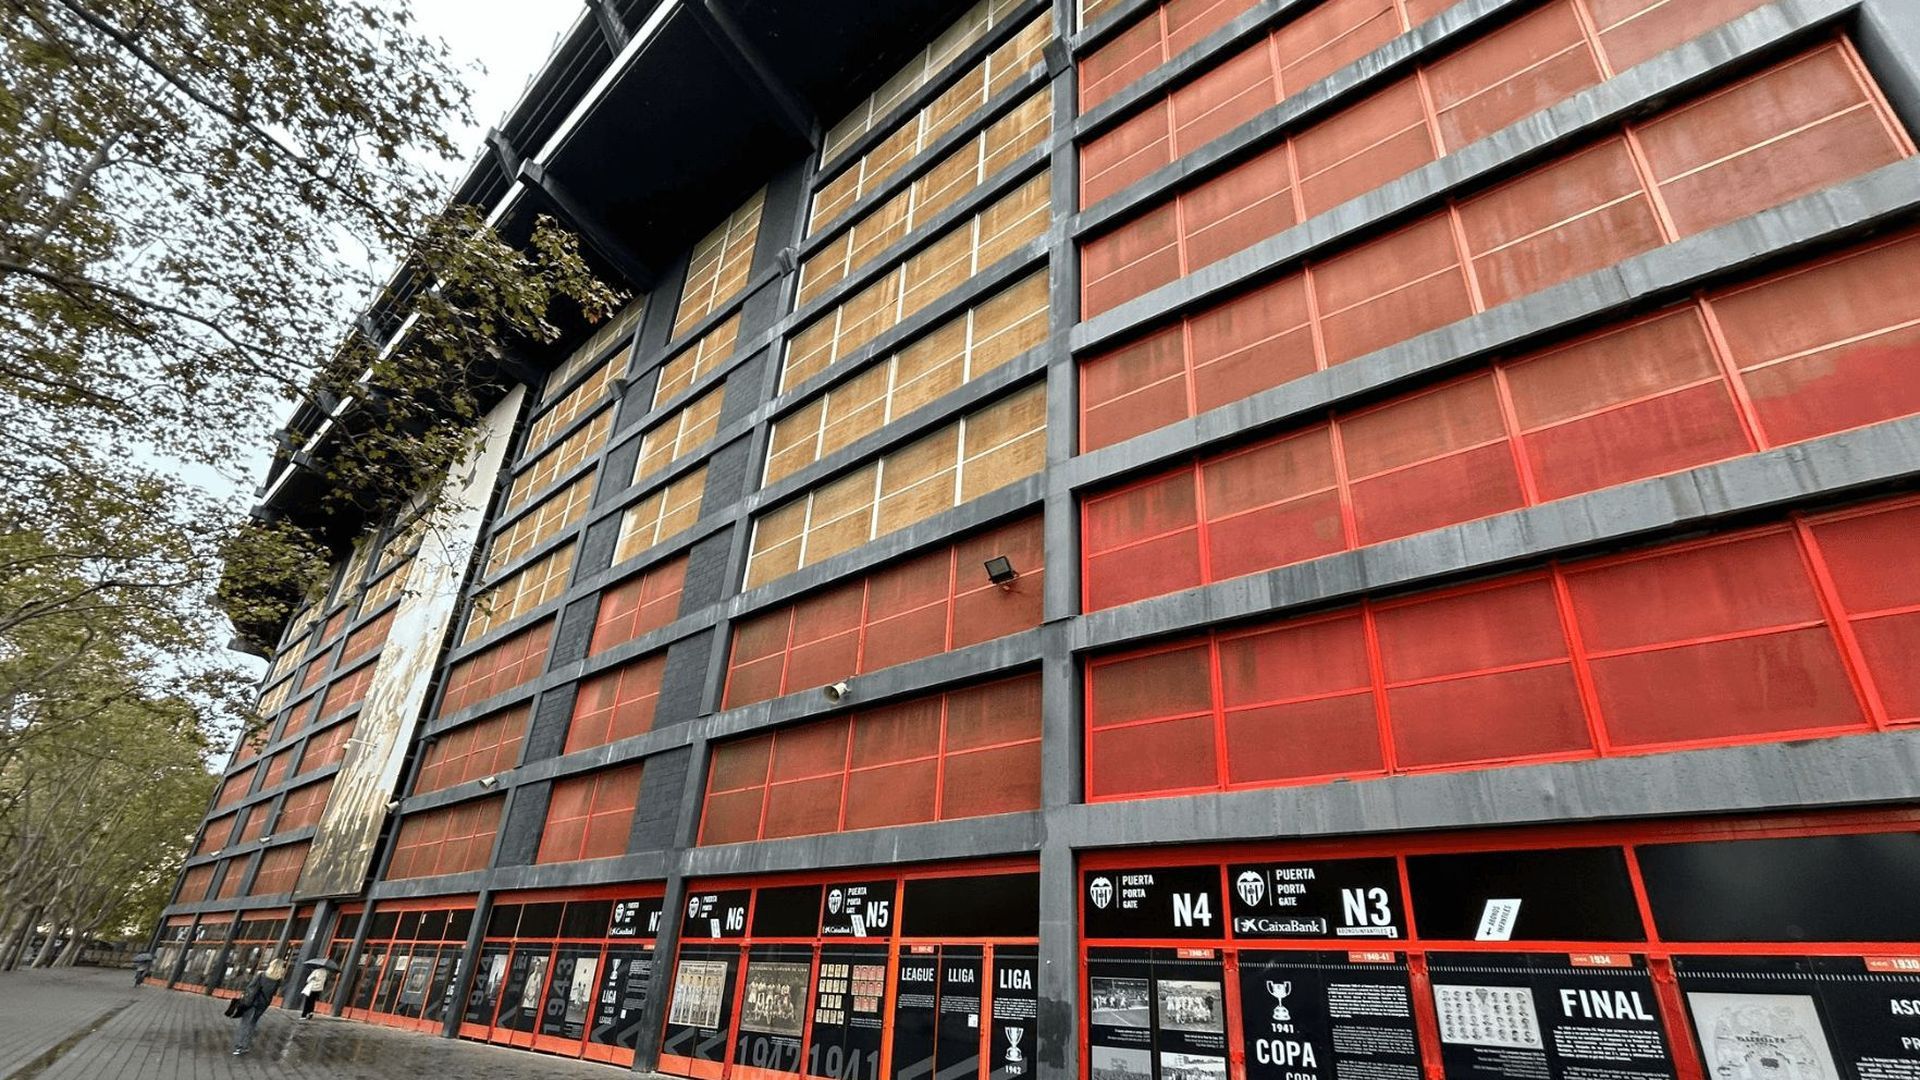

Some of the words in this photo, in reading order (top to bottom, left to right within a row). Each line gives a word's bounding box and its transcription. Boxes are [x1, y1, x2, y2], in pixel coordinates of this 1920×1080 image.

[1122, 874, 1154, 885] PUERTA
[1276, 868, 1315, 881] PUERTA
[1122, 888, 1146, 898] PORTA
[1277, 883, 1306, 894] PORTA
[1122, 900, 1138, 909] GATE
[1278, 897, 1297, 906] GATE
[1341, 887, 1391, 926] N3
[866, 901, 889, 928] N5
[1172, 892, 1212, 927] N4
[726, 907, 745, 930] N6
[1258, 919, 1320, 933] CaixaBank
[901, 967, 935, 981] LEAGUE
[948, 968, 975, 983] LLIGA
[999, 968, 1032, 990] LIGA
[543, 958, 575, 1035] 1943
[1559, 989, 1654, 1021] FINAL
[1271, 1023, 1294, 1034] 1941
[1256, 1038, 1317, 1068] COPA
[1005, 1065, 1021, 1075] 1942
